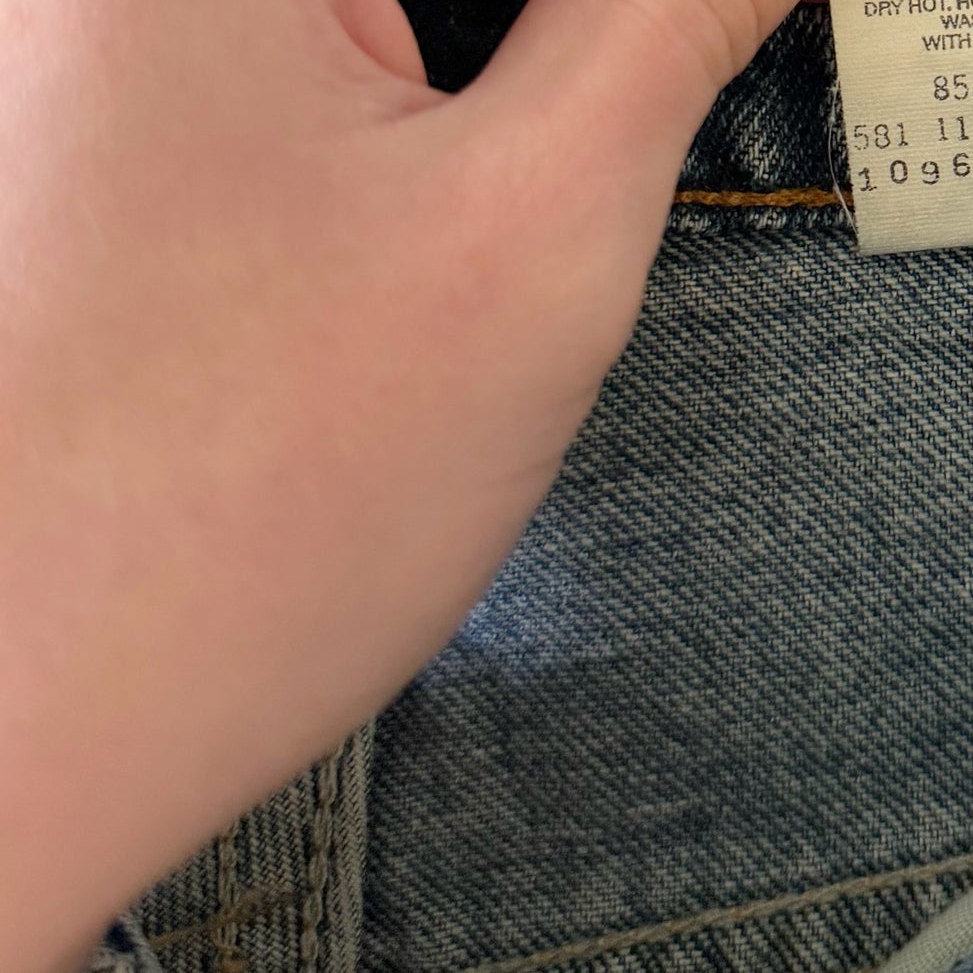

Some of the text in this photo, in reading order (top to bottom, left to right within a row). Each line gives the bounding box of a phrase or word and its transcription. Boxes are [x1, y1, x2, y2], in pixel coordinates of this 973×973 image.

[864, 0, 904, 17] DRY
[923, 34, 971, 50] WITH
[854, 122, 909, 150] 581
[937, 116, 969, 141] 11
